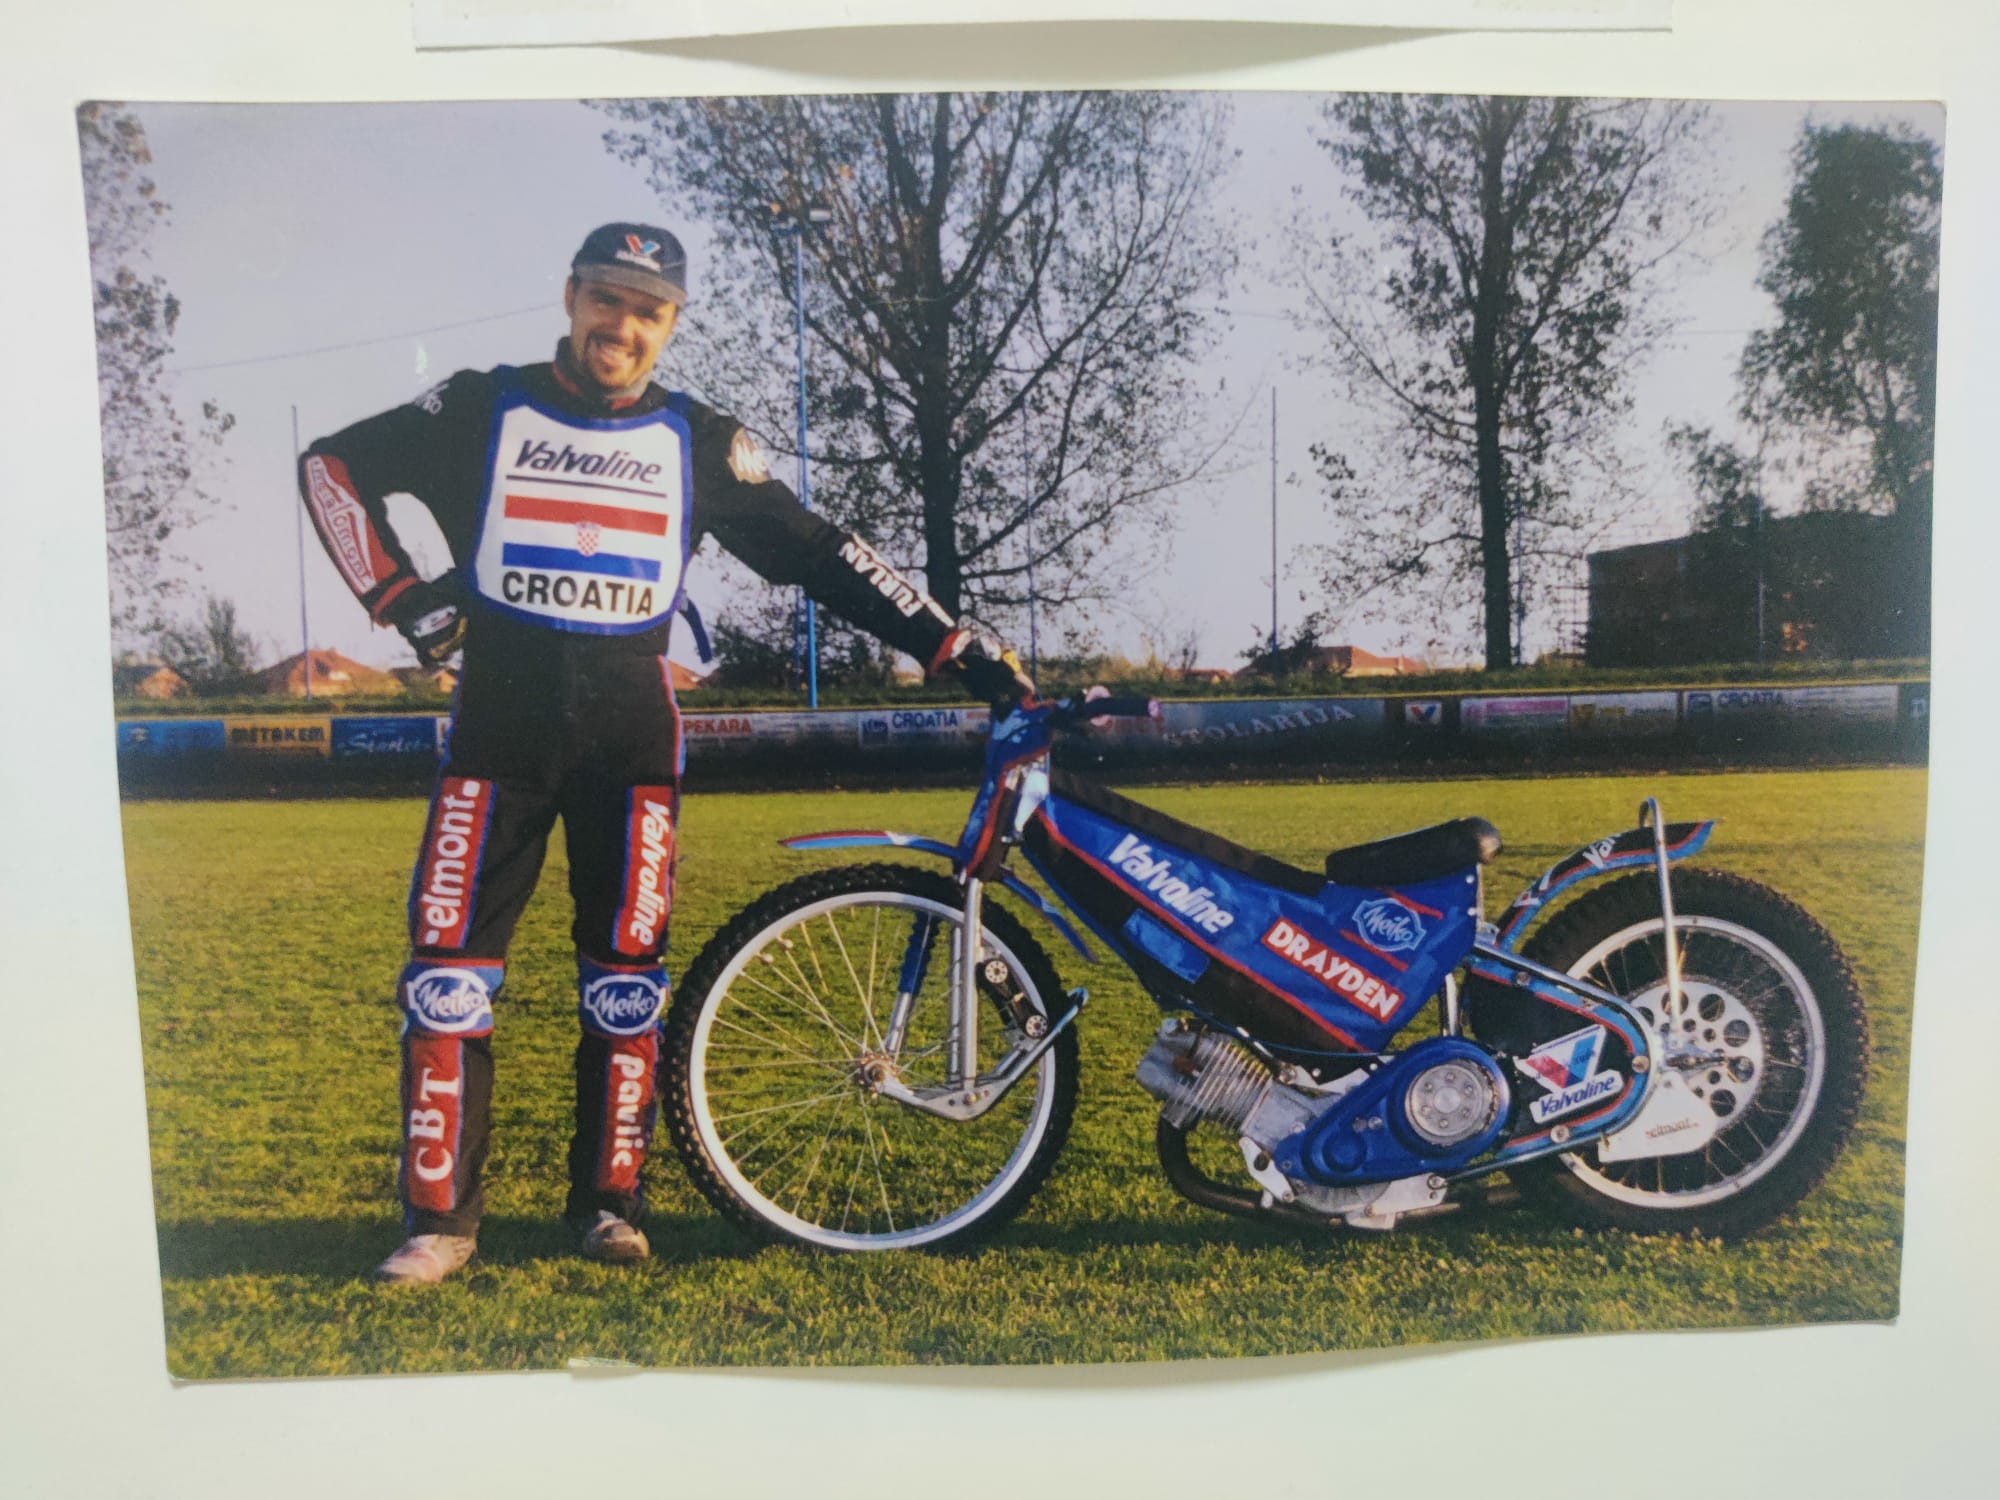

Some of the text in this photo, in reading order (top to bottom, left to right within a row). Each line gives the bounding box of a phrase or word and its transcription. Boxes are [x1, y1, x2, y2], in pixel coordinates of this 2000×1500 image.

[515, 439, 662, 484] Valvoline
[502, 571, 653, 616] CROATIA
[838, 541, 924, 618] FURLAN
[682, 718, 752, 735] PEKARA
[892, 711, 957, 728] CROATIA
[629, 799, 670, 946] Valvoline
[1105, 833, 1234, 934] Valvoline
[1267, 922, 1400, 1021] DRAYDEN
[593, 986, 655, 1023] Meiko
[1539, 1076, 1615, 1117] Valvoline
[409, 1067, 460, 1181] CBT
